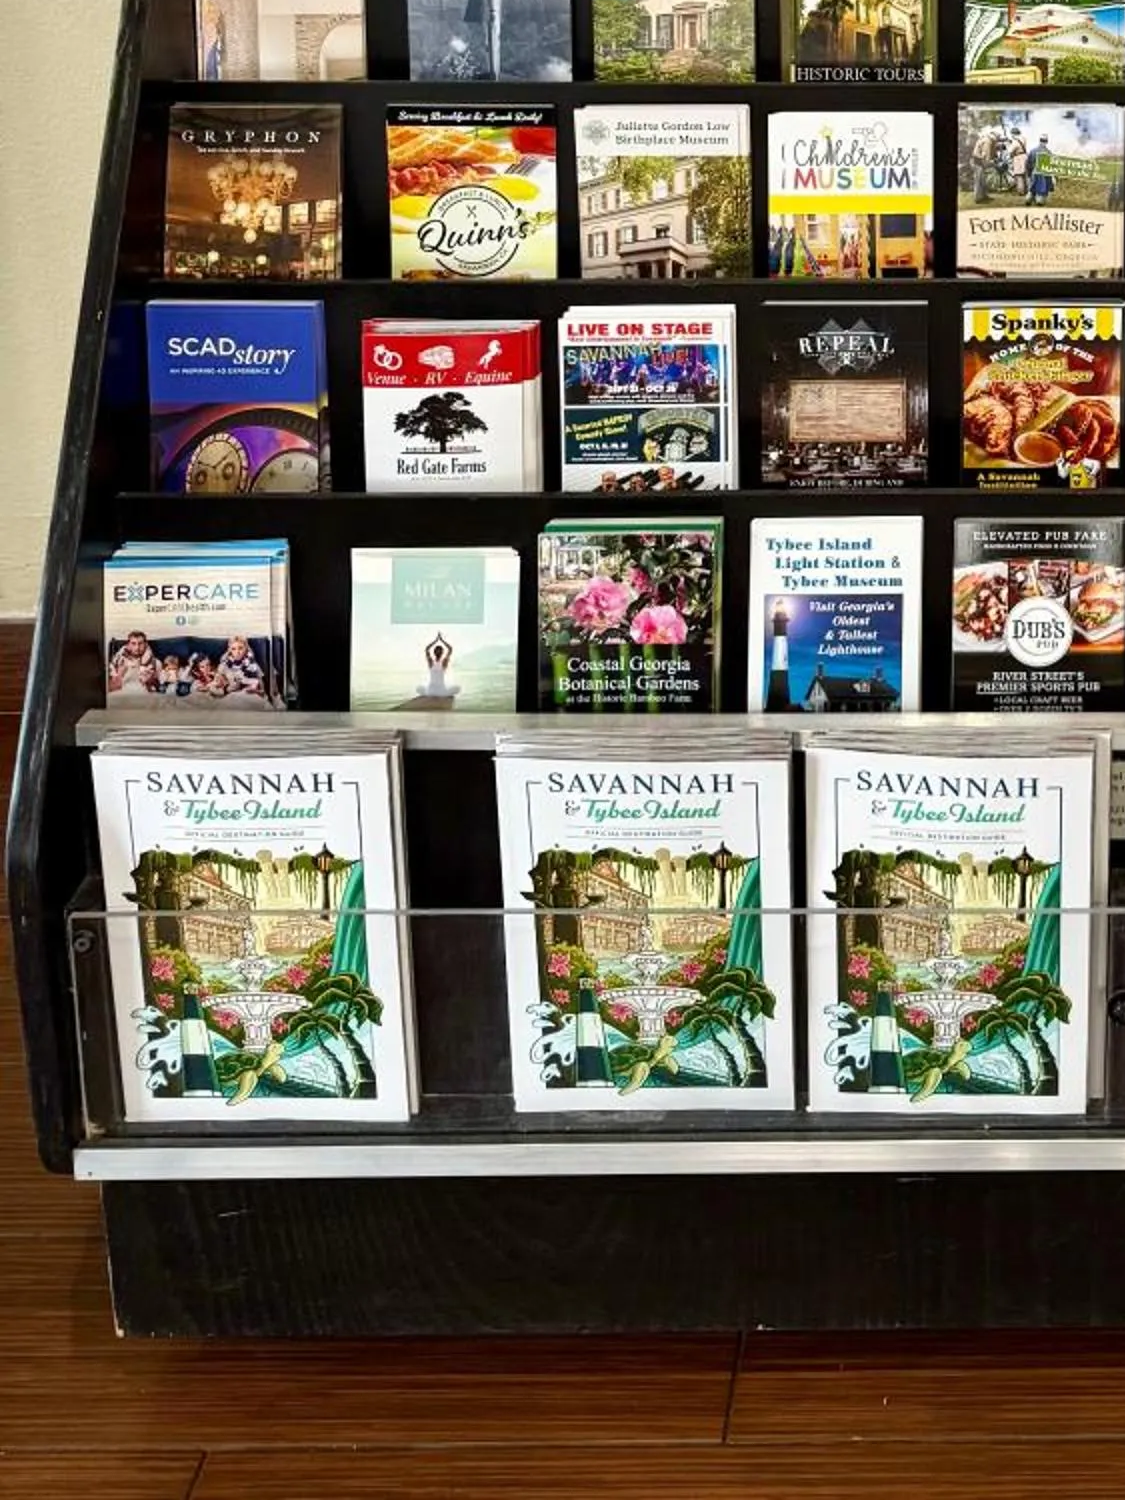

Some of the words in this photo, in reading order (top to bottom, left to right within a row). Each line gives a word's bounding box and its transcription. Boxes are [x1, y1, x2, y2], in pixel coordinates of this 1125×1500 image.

[797, 67, 869, 81] HISTORIC
[874, 68, 924, 81] TOURS
[182, 131, 320, 143] GRYPHON
[615, 135, 675, 147] Birthplace
[679, 135, 728, 145] Museum
[794, 167, 910, 189] MUSEUM
[418, 208, 527, 256] Quinn's
[970, 214, 1006, 235] Fort
[1011, 213, 1104, 236] McAllister
[567, 324, 612, 336] LIVE
[617, 324, 644, 336] ON
[652, 324, 713, 335] STAGE
[992, 314, 1094, 334] Spanky's
[367, 372, 406, 385] Venue
[425, 372, 446, 385] RV
[465, 370, 512, 385] Equine
[396, 458, 419, 474] Red
[422, 458, 448, 474] Gate
[451, 458, 486, 474] Farms
[766, 538, 812, 551] Tybee
[819, 538, 871, 549] Island
[114, 583, 259, 602] EXPERCARE
[809, 602, 835, 612] Visit
[839, 601, 895, 614] Georgia's
[832, 615, 869, 626] Oldest
[1012, 617, 1065, 639] DUB'S
[825, 630, 835, 640] &
[841, 629, 878, 639] Tallest
[818, 644, 883, 656] Lighthouse
[567, 656, 625, 673] Coastal
[629, 656, 691, 675] Georgia
[559, 675, 631, 691] Botanical
[636, 675, 700, 691] Gardens
[993, 672, 1027, 680] RIVER
[1031, 672, 1084, 680] STREET'S
[147, 772, 335, 794] SAVANNAH
[548, 773, 734, 794] SAVANNAH
[857, 770, 1039, 797] SAVANNAH
[163, 802, 179, 817] &
[180, 800, 241, 824] Tybee
[244, 799, 321, 820] Island
